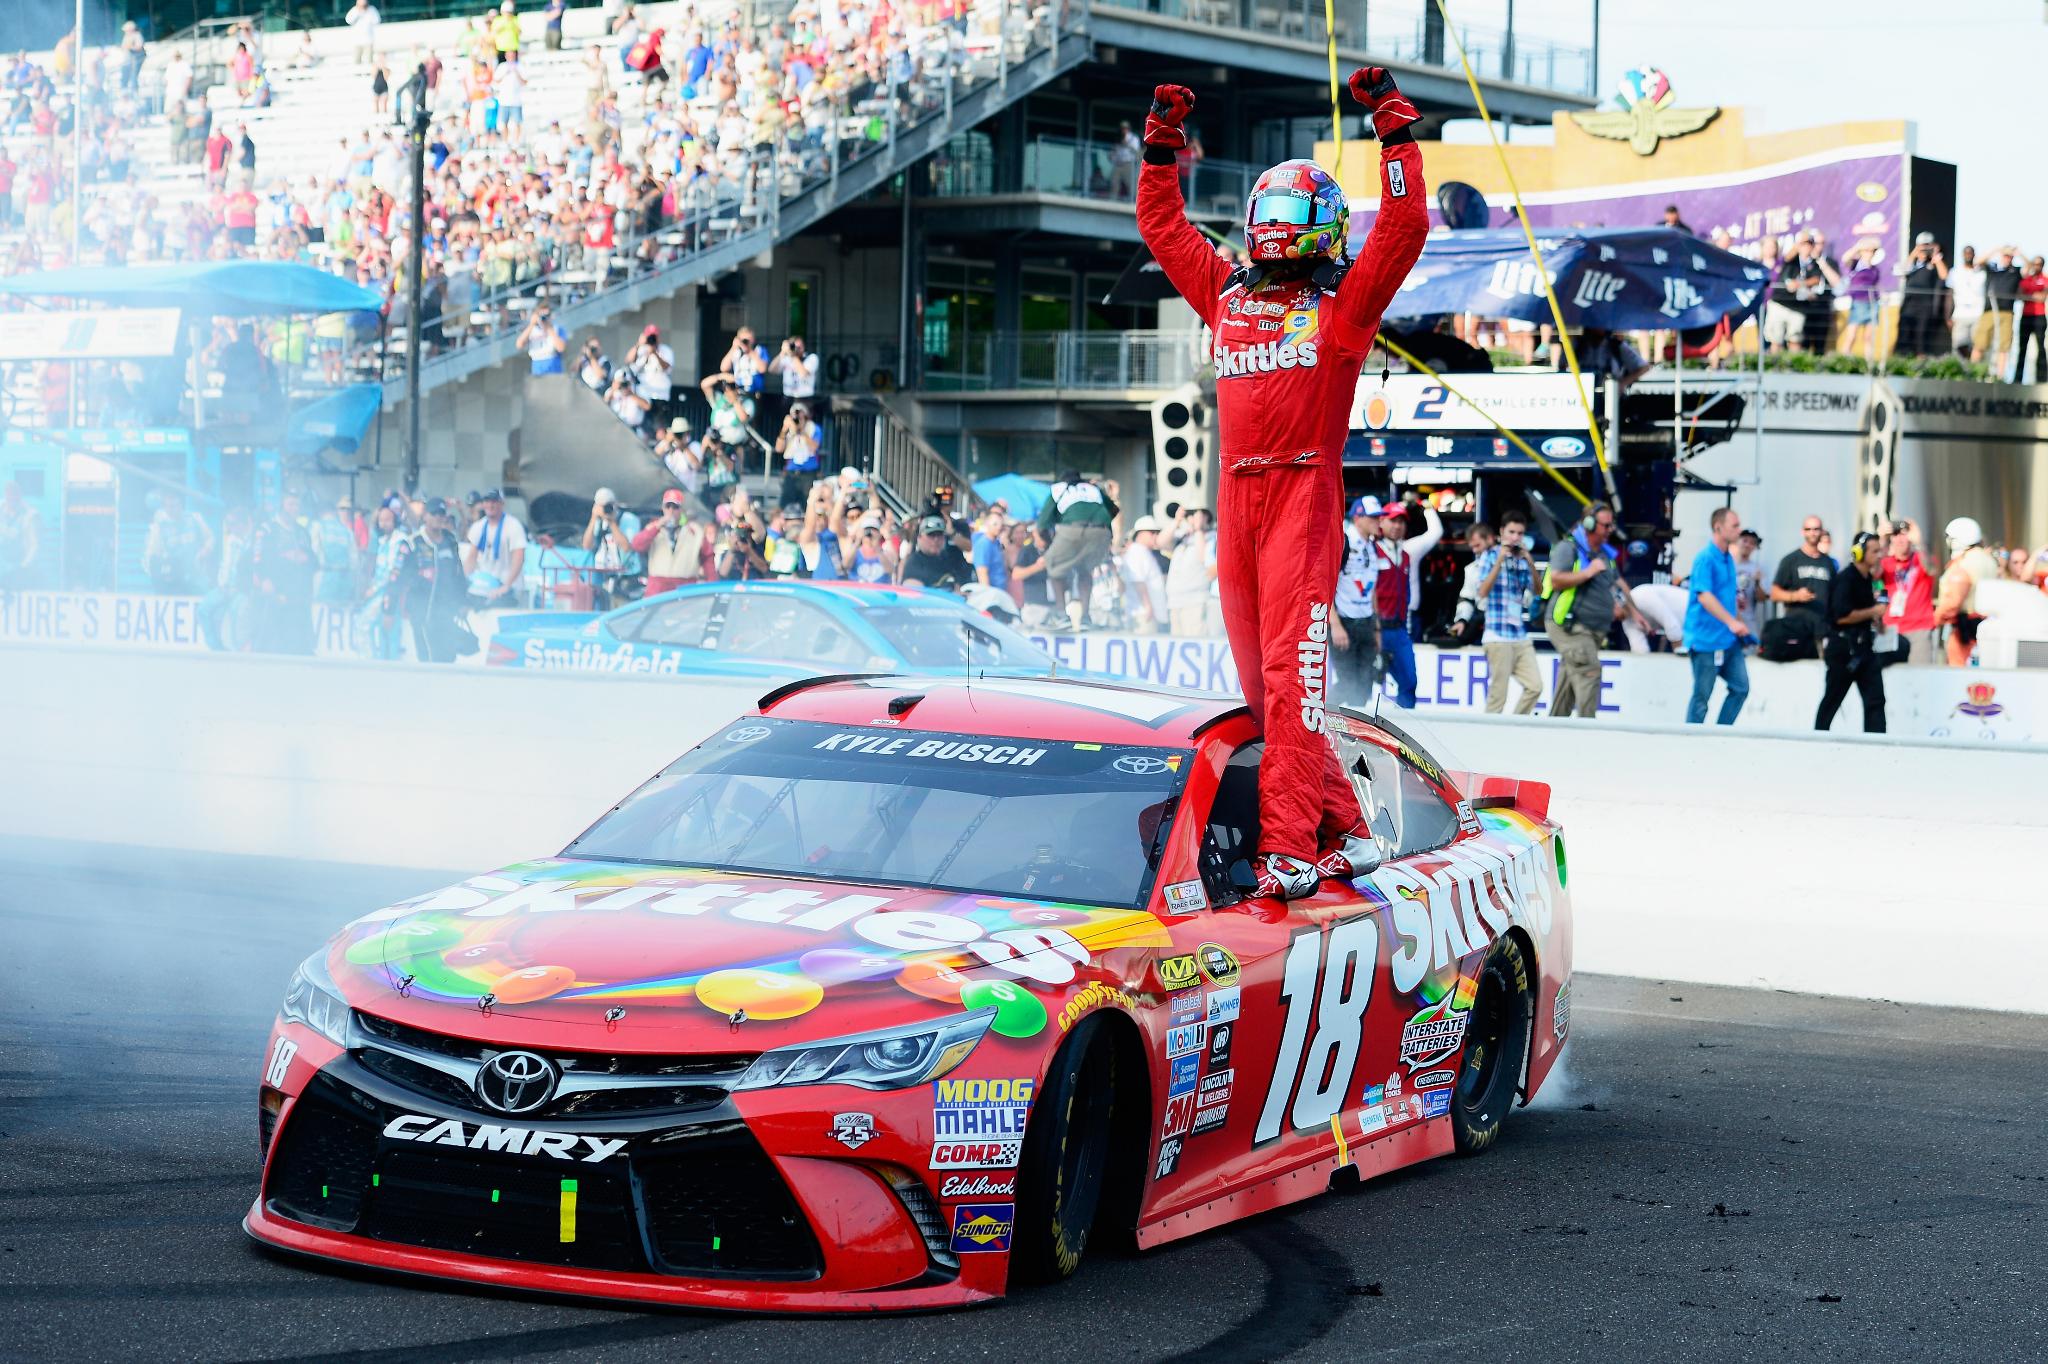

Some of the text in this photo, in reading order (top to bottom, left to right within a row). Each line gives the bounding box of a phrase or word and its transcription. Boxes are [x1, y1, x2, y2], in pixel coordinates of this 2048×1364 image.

[1257, 230, 1288, 244] Skittles
[1573, 269, 1627, 309] Lite
[1214, 340, 1318, 380] Skittles
[1413, 386, 1449, 420] 2
[1783, 392, 1859, 411] SPEEDWAY
[1298, 602, 1329, 735] Skittles
[813, 732, 1048, 767] KYLE BUSCH
[1399, 741, 1441, 782] STANLEY
[345, 874, 1091, 985] Skittles
[1058, 981, 1136, 1032] GOODYEAR
[1168, 1026, 1195, 1052] Mobil
[1255, 919, 1380, 1144] 18
[1404, 1018, 1464, 1040] INTERSTATE
[1402, 1035, 1459, 1055] BATTERIES
[265, 1036, 299, 1089] 18
[936, 1078, 1033, 1103] MOOG
[1201, 1074, 1228, 1091] LINCOLN
[1418, 1074, 1451, 1086] FREIGHTLINER
[1204, 1088, 1229, 1103] WELDERS
[1385, 1088, 1402, 1098] TOOLS
[935, 1109, 1026, 1134] MAHLE
[1164, 1095, 1193, 1135] 3M
[383, 1115, 628, 1163] CAMRY
[837, 1126, 870, 1141] 25
[935, 1144, 1002, 1164] COMP
[980, 1158, 1013, 1166] CAMS
[941, 1176, 1014, 1197] Edelbrock
[957, 1223, 1012, 1237] SUNOCO
